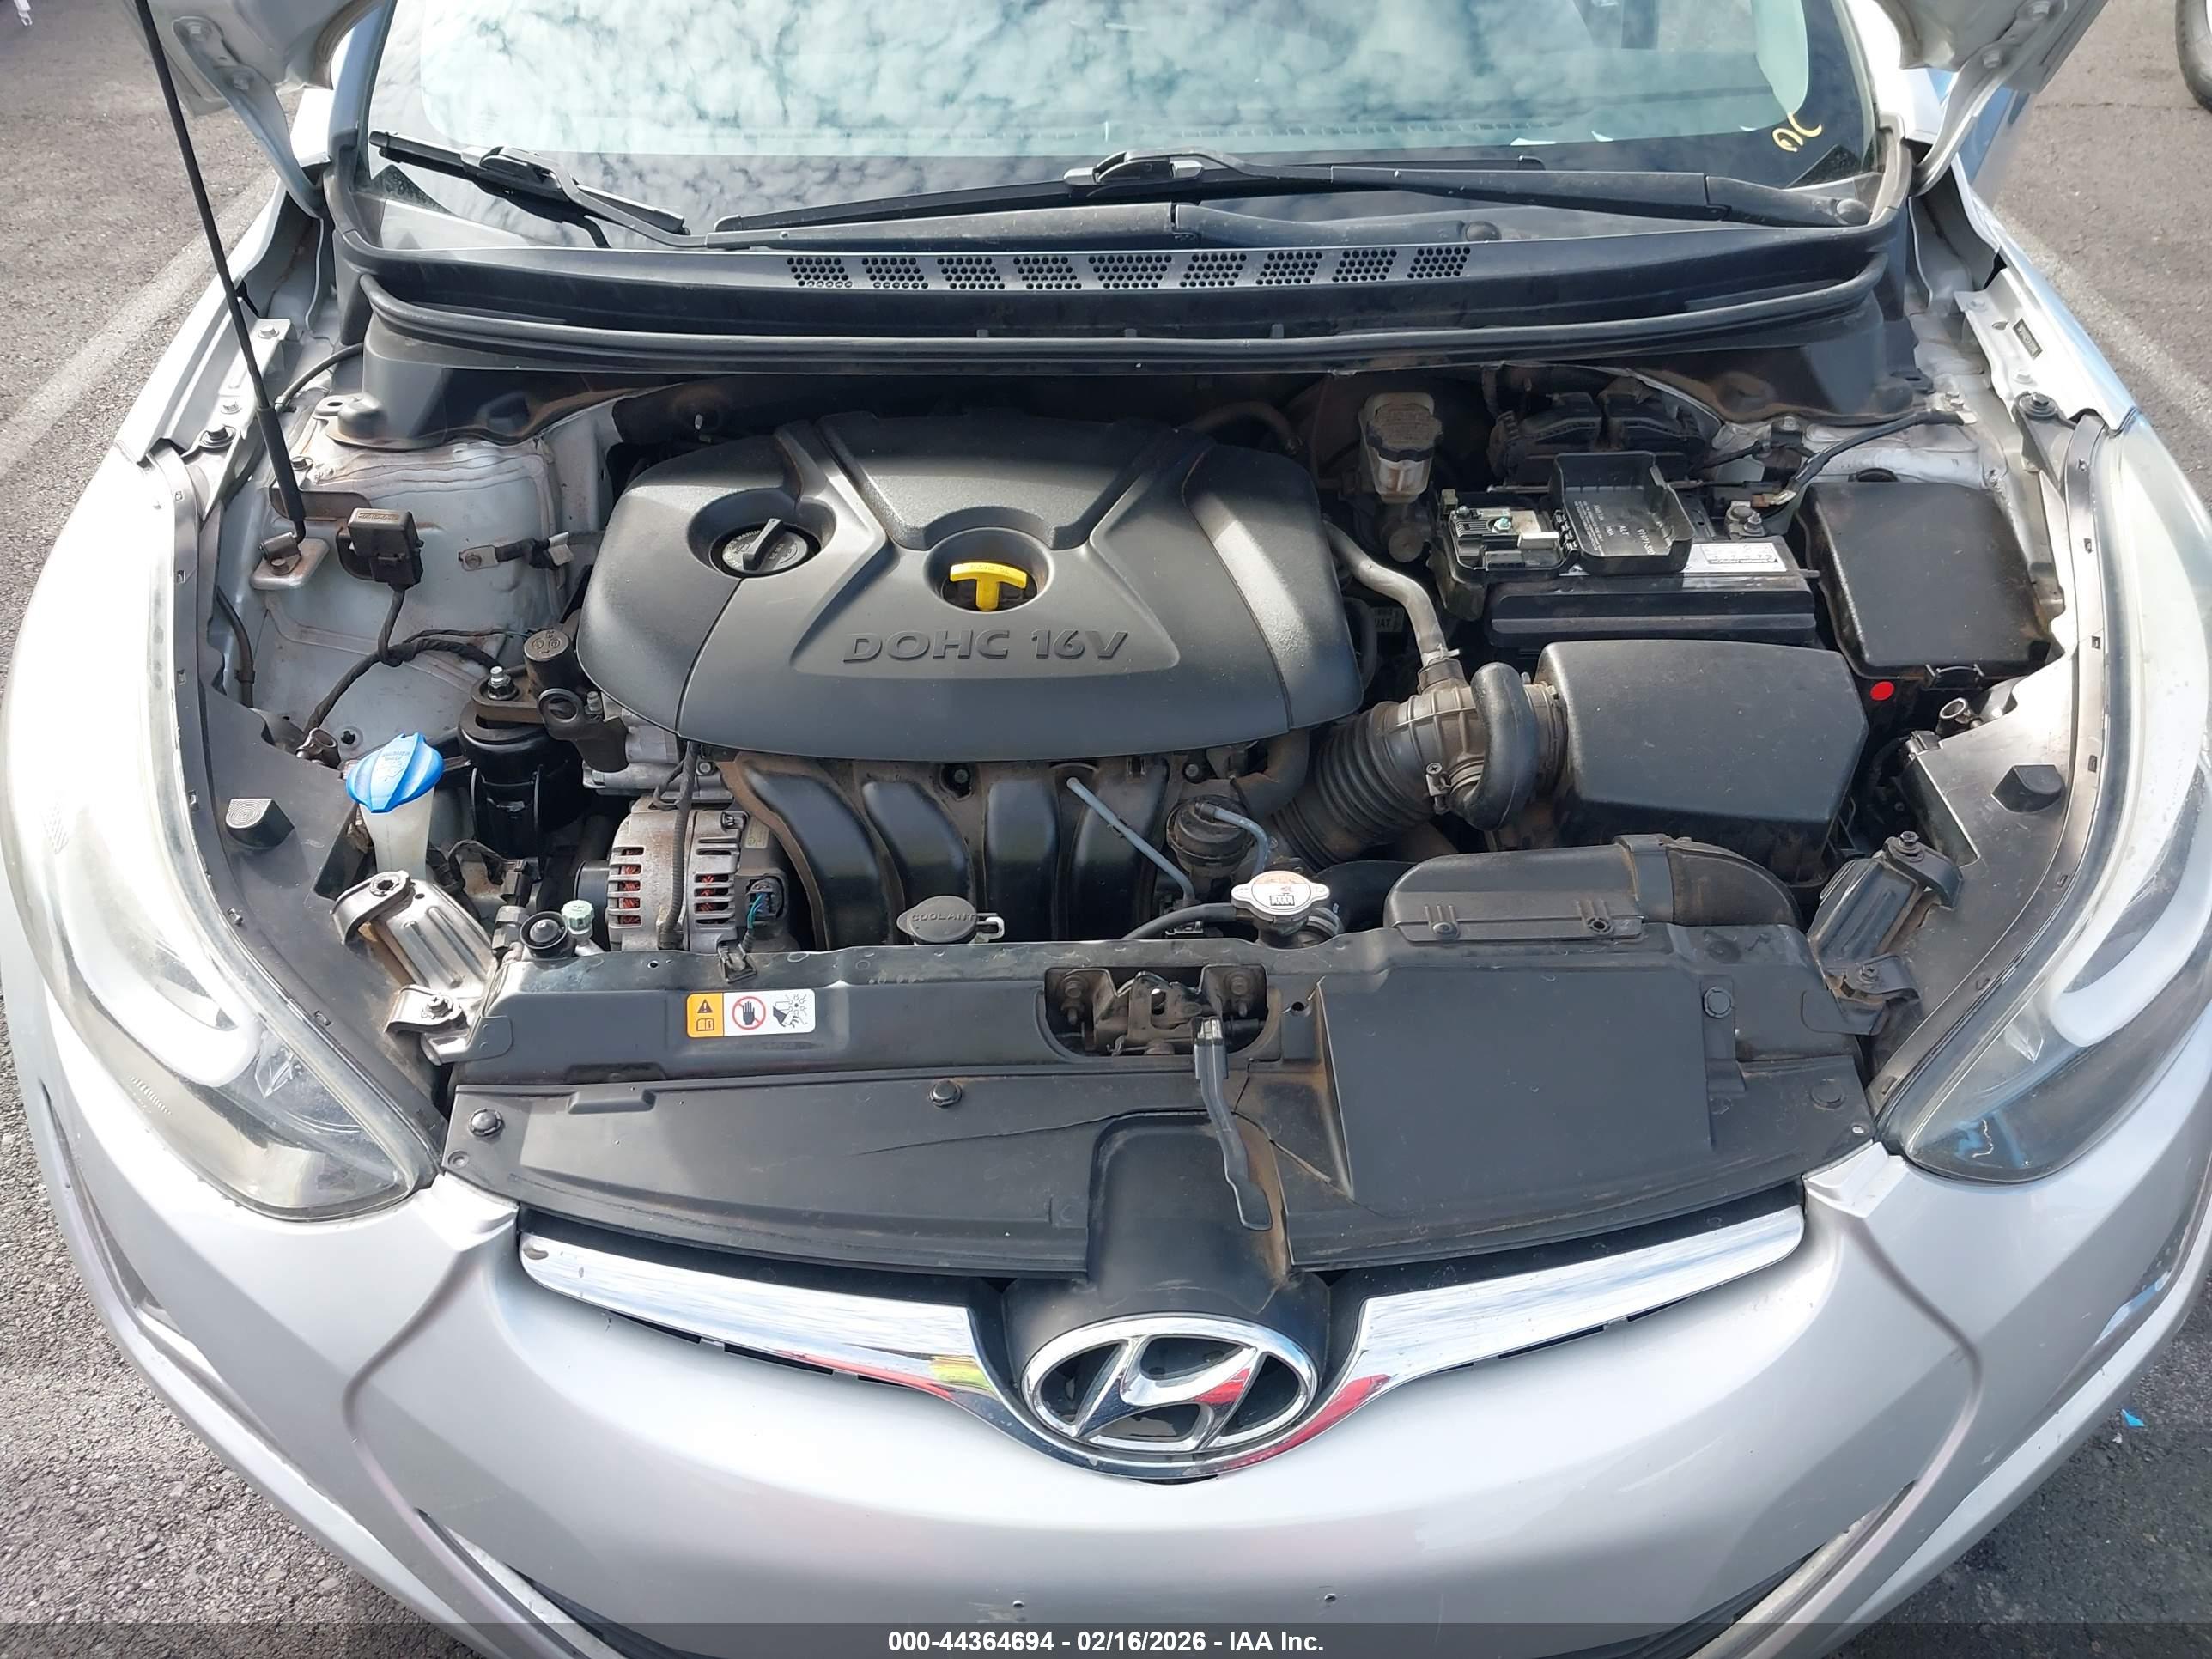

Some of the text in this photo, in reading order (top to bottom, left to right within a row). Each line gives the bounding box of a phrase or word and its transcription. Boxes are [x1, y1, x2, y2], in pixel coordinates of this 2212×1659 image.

[842, 629, 1129, 663] DOHC 16V
[911, 912, 977, 922] COOLANT
